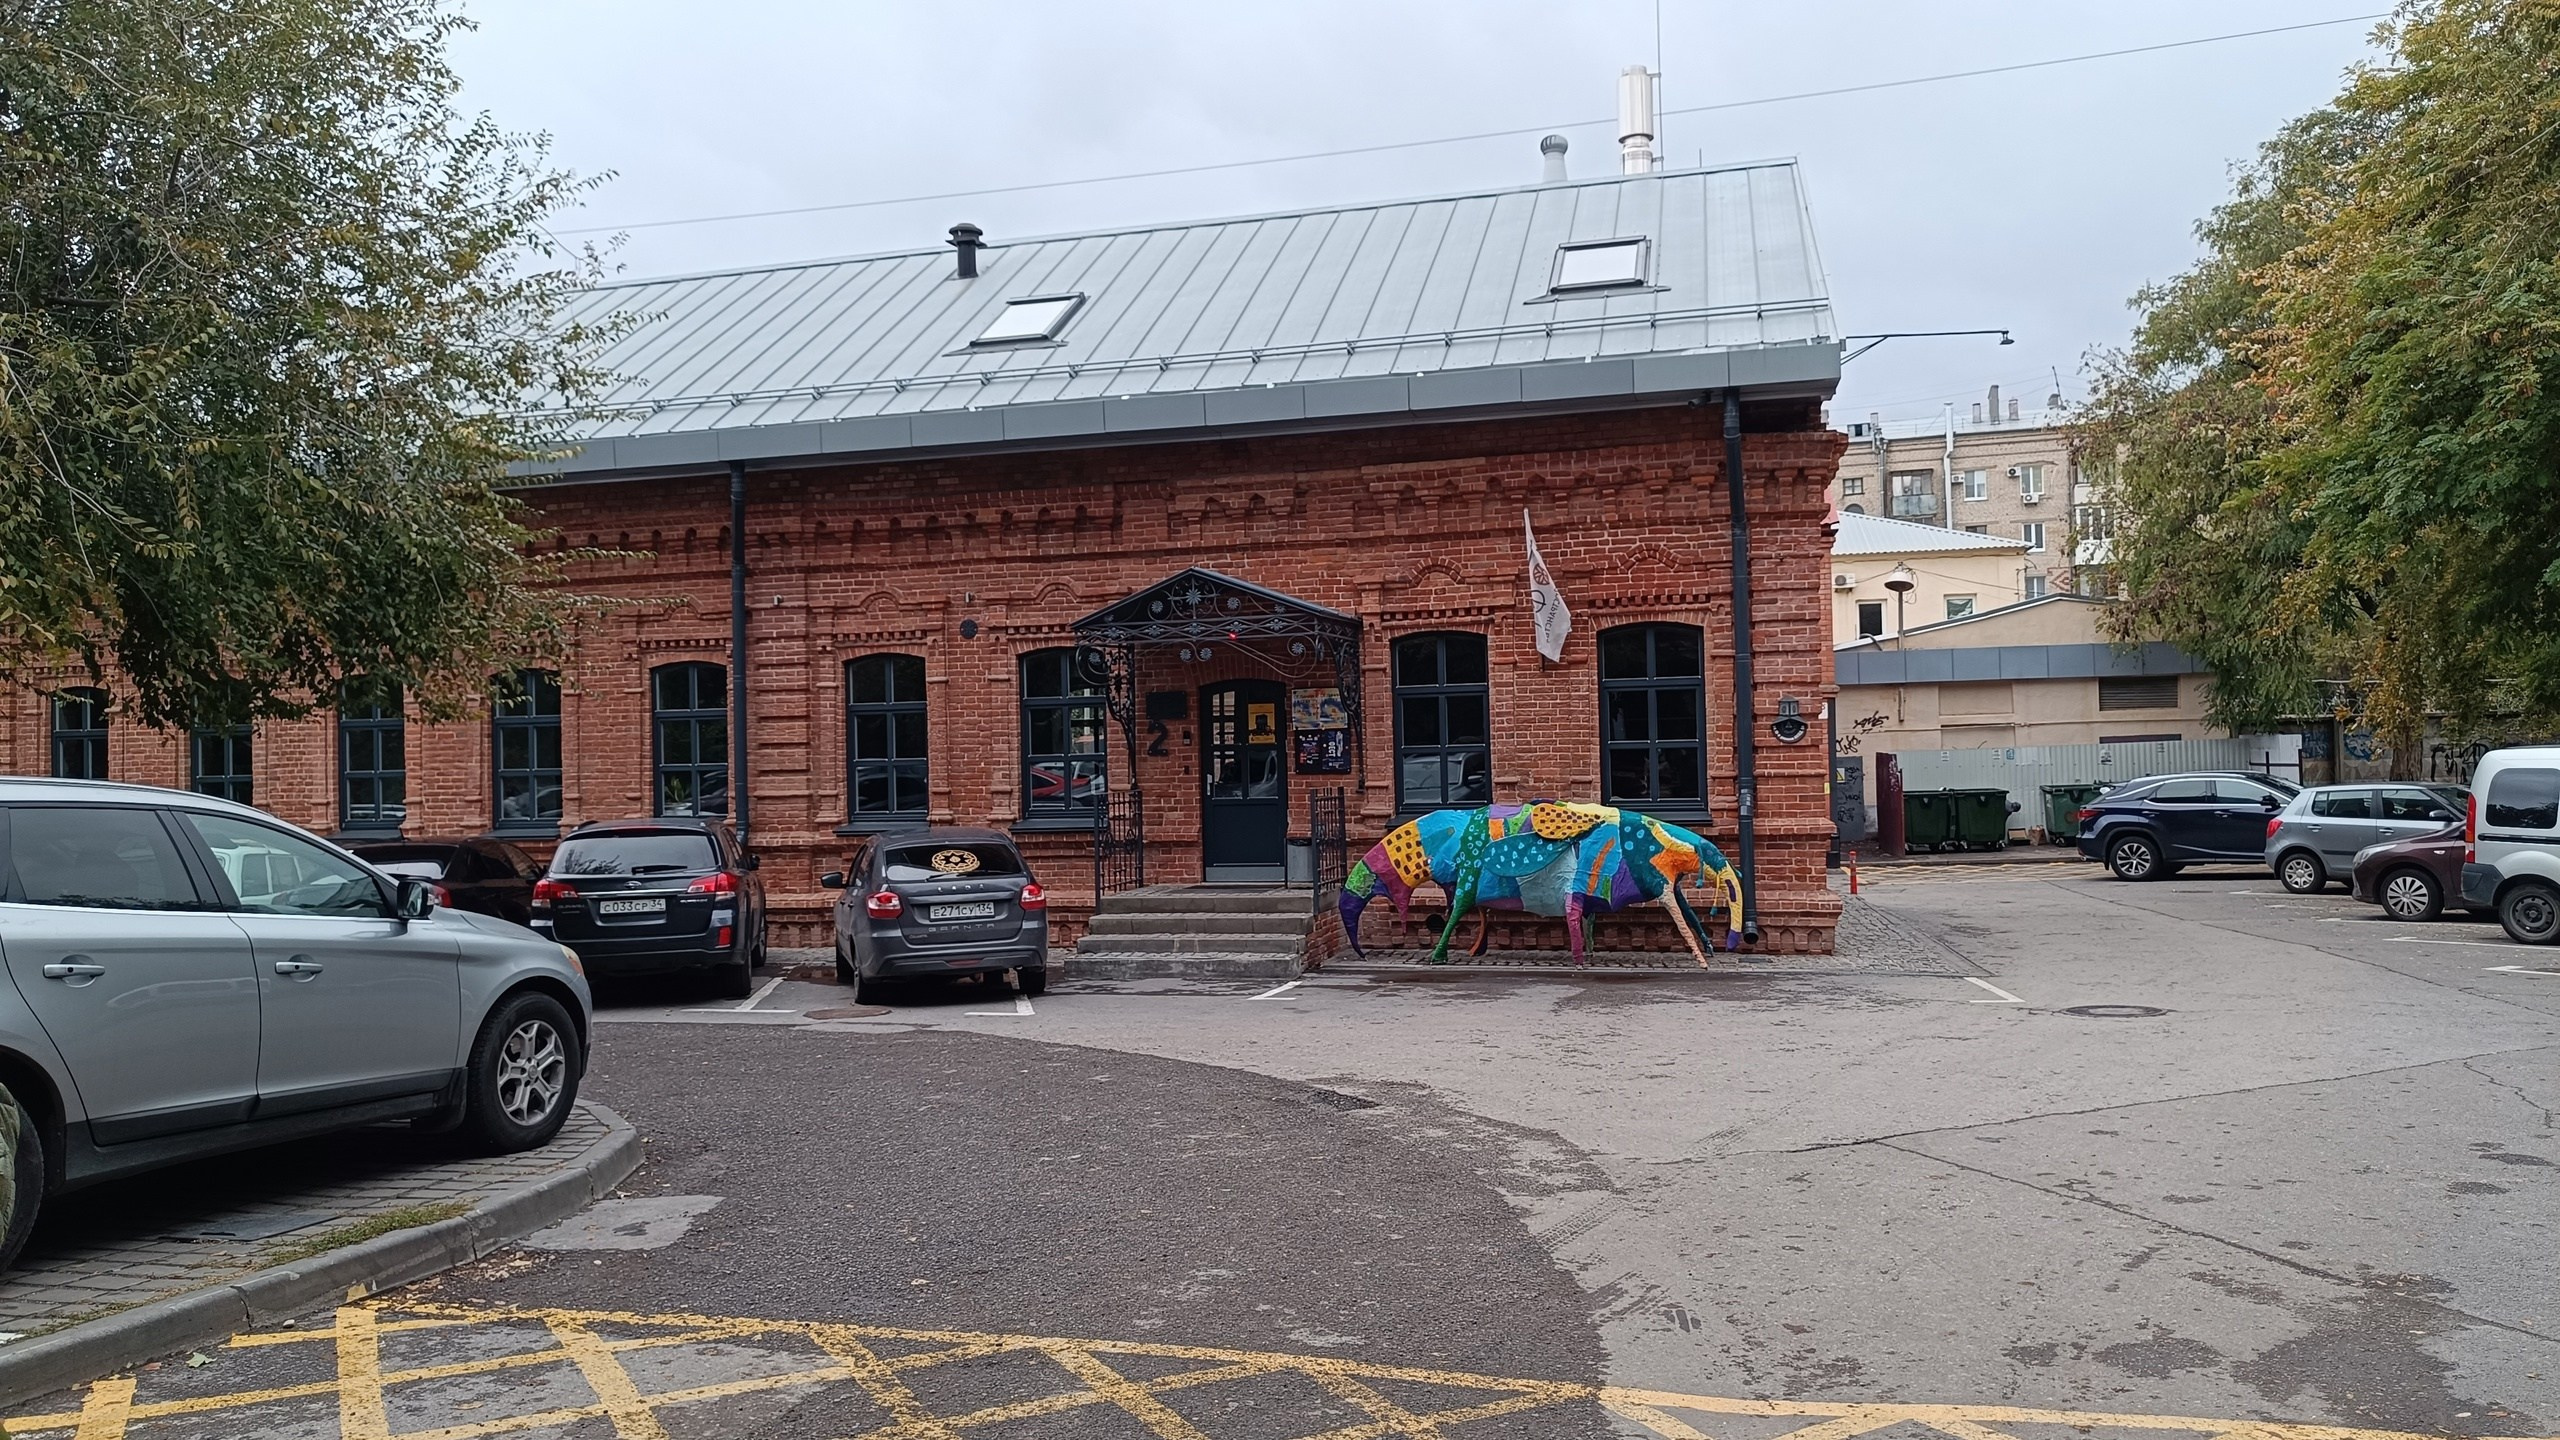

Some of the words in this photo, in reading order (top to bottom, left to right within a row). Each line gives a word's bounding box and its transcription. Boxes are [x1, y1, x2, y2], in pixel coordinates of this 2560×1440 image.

[1147, 720, 1168, 756] 2
[604, 901, 648, 912] С033СР
[651, 899, 663, 908] 34
[933, 904, 975, 917] Е271СУ
[976, 903, 992, 912] 134
